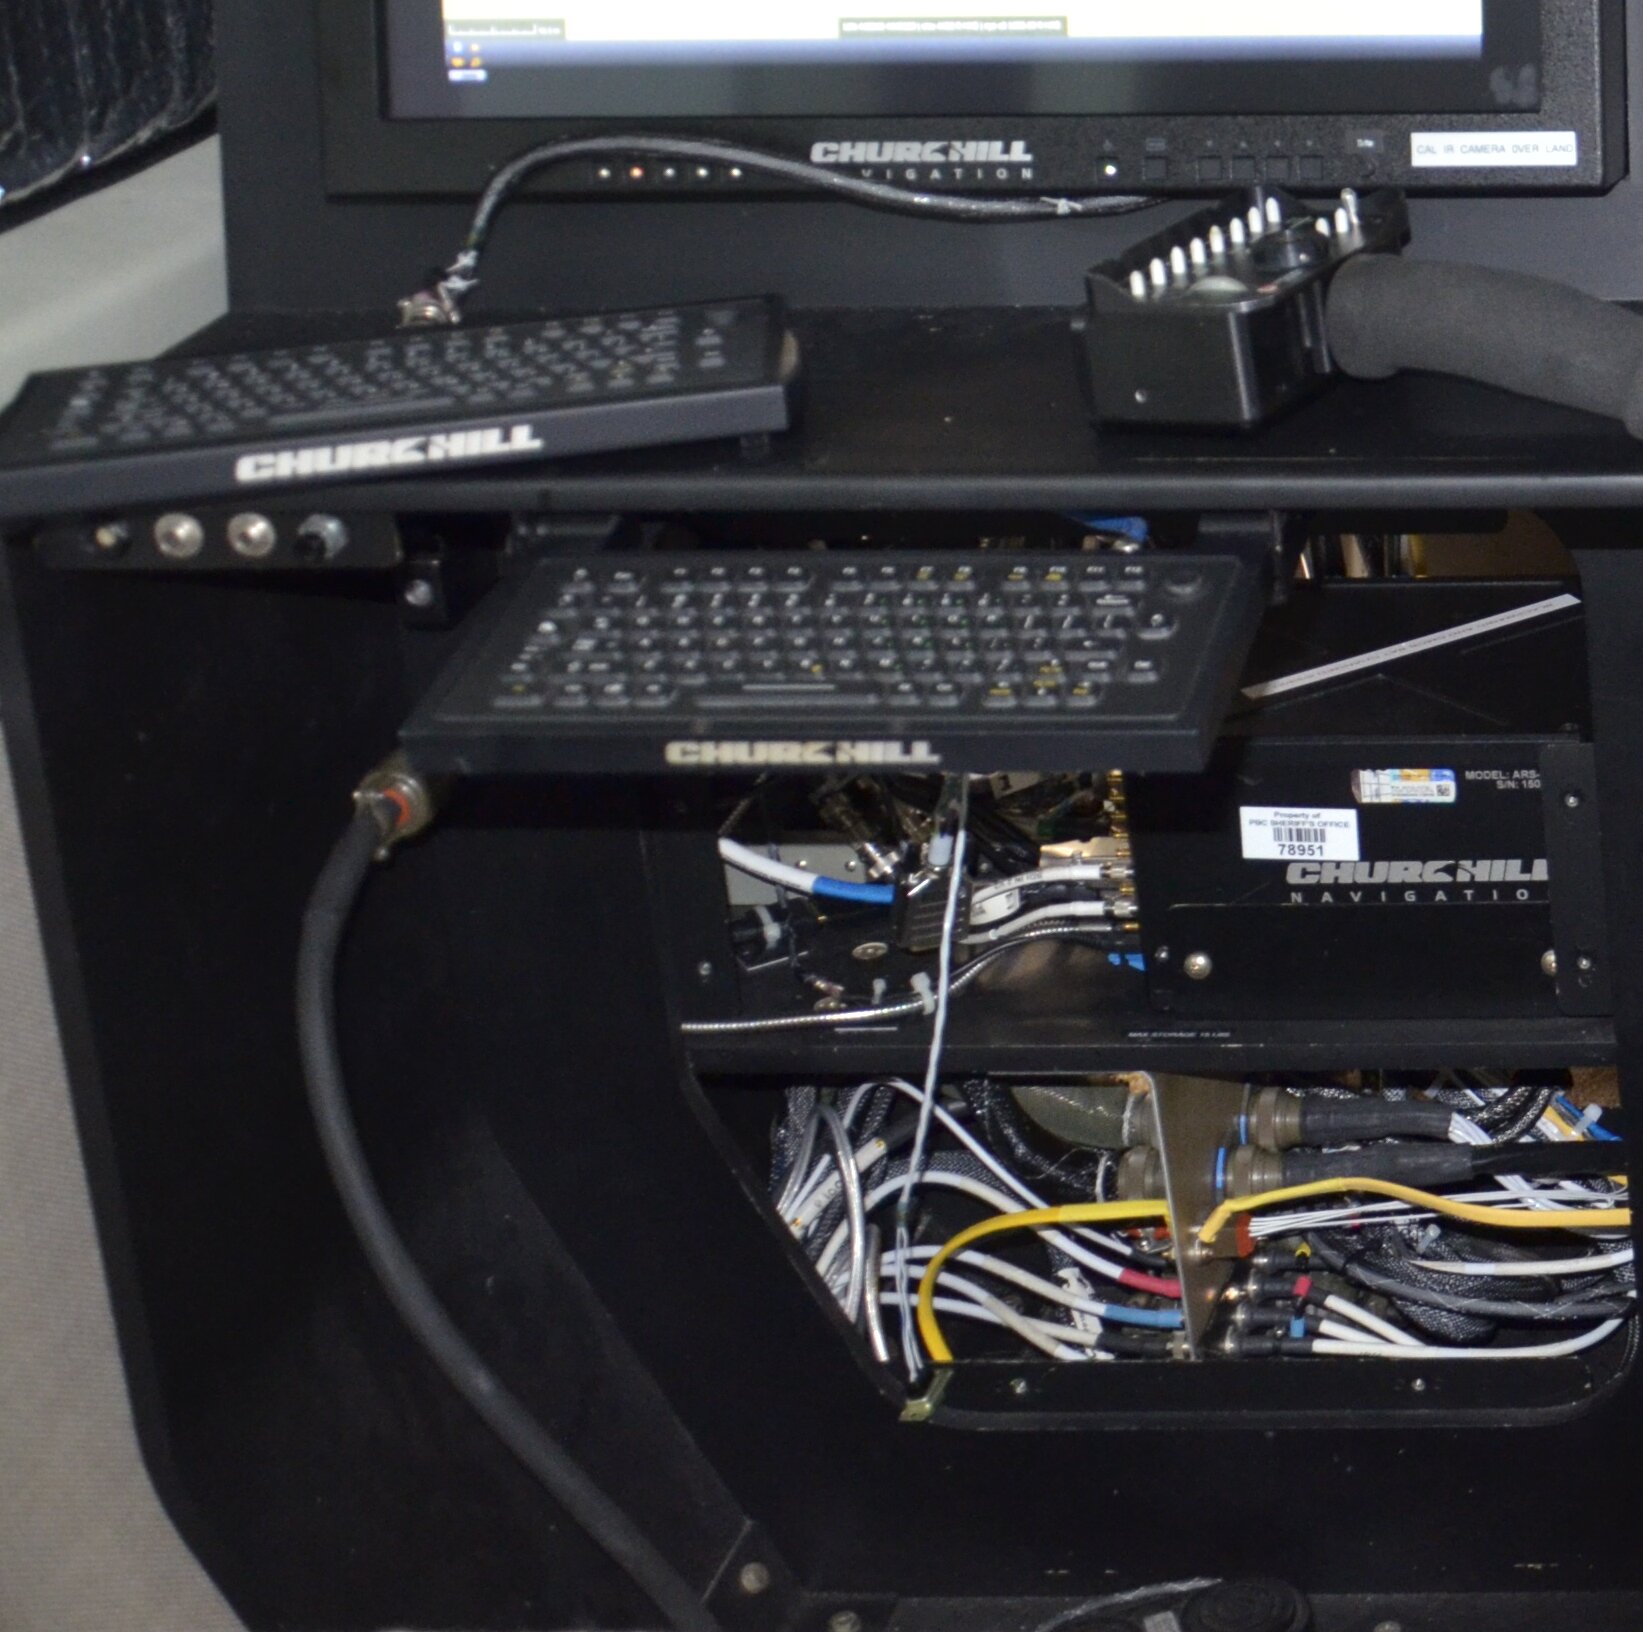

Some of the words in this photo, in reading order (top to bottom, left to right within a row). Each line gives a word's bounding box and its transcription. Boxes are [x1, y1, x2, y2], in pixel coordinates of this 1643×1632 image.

[810, 140, 1033, 164] CHURCHILL
[1416, 145, 1436, 154] CAL
[1443, 144, 1454, 153] IR
[1460, 145, 1506, 154] CAMERA
[1512, 144, 1539, 153] OVER
[1546, 144, 1573, 153] LAND
[862, 168, 1033, 180] VIGATION
[234, 424, 546, 485] CHURCHILL
[664, 741, 942, 765] CHURCHILL
[1465, 770, 1509, 780] MODEL:
[1496, 780, 1519, 789] S/N:
[1274, 811, 1310, 820] Property
[1312, 811, 1321, 819] of
[1270, 820, 1315, 828] SHERIFF'S
[1317, 821, 1349, 829] OFFICE
[1277, 844, 1325, 857] 78951
[1286, 859, 1548, 884] CHURCHILL
[1291, 889, 1529, 903] NAVIGATIO
